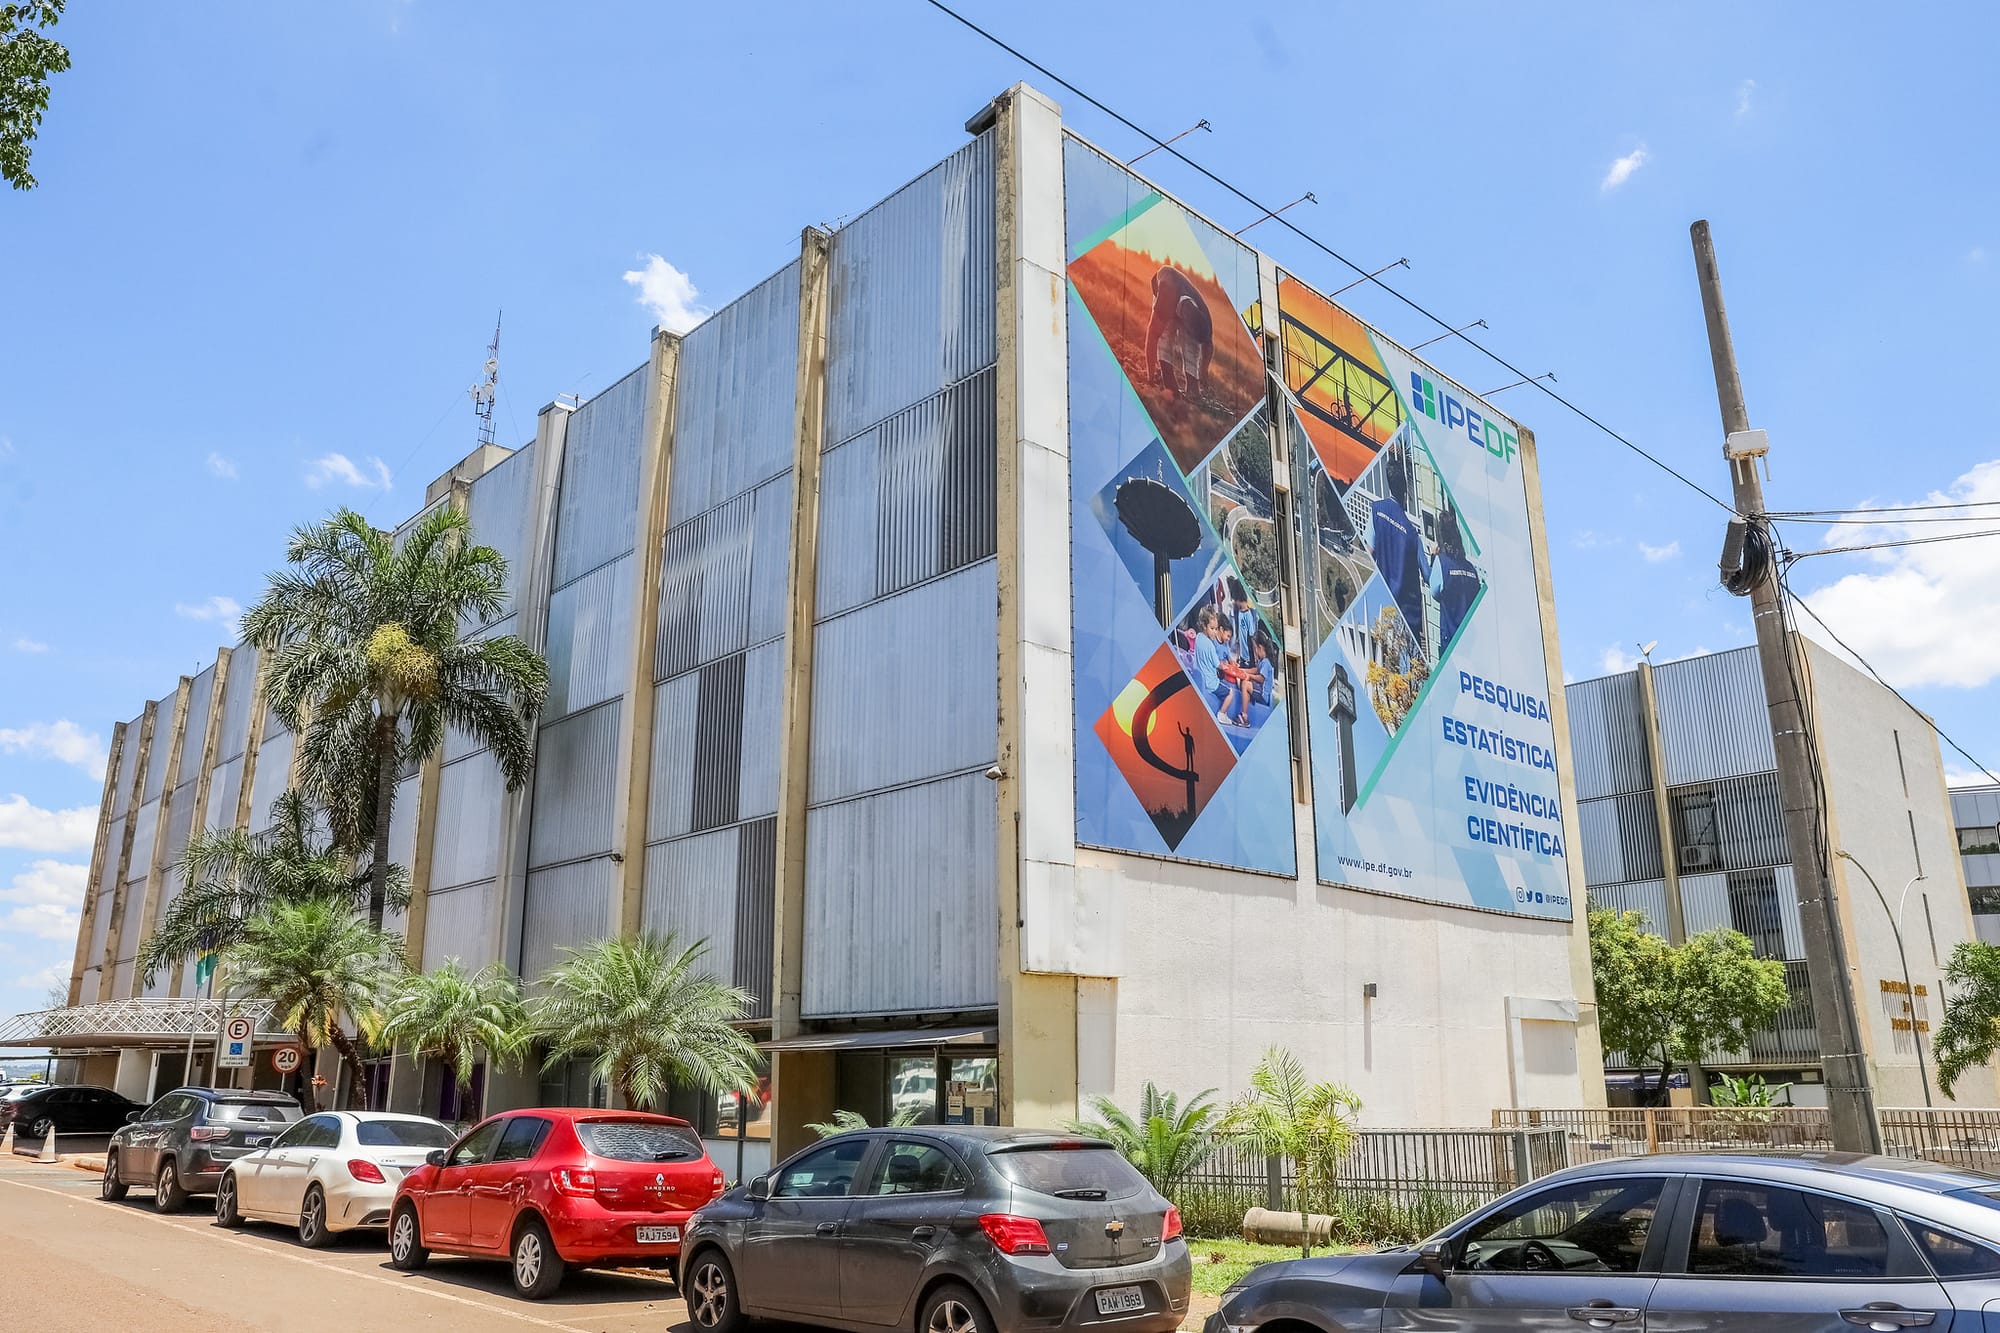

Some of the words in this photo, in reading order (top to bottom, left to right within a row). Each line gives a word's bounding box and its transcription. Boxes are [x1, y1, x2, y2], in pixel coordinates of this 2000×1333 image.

[1438, 390, 1518, 464] IPEDF
[1459, 670, 1549, 723] PESQUISA
[1442, 716, 1555, 772] ESTATÍSTICA
[1464, 775, 1560, 822] EVIDÊNCIA
[1467, 815, 1564, 858] CIENTÍFICA
[1337, 855, 1413, 879] www.ipe.df.gov.br
[234, 1023, 243, 1036] E
[278, 1051, 297, 1063] 20
